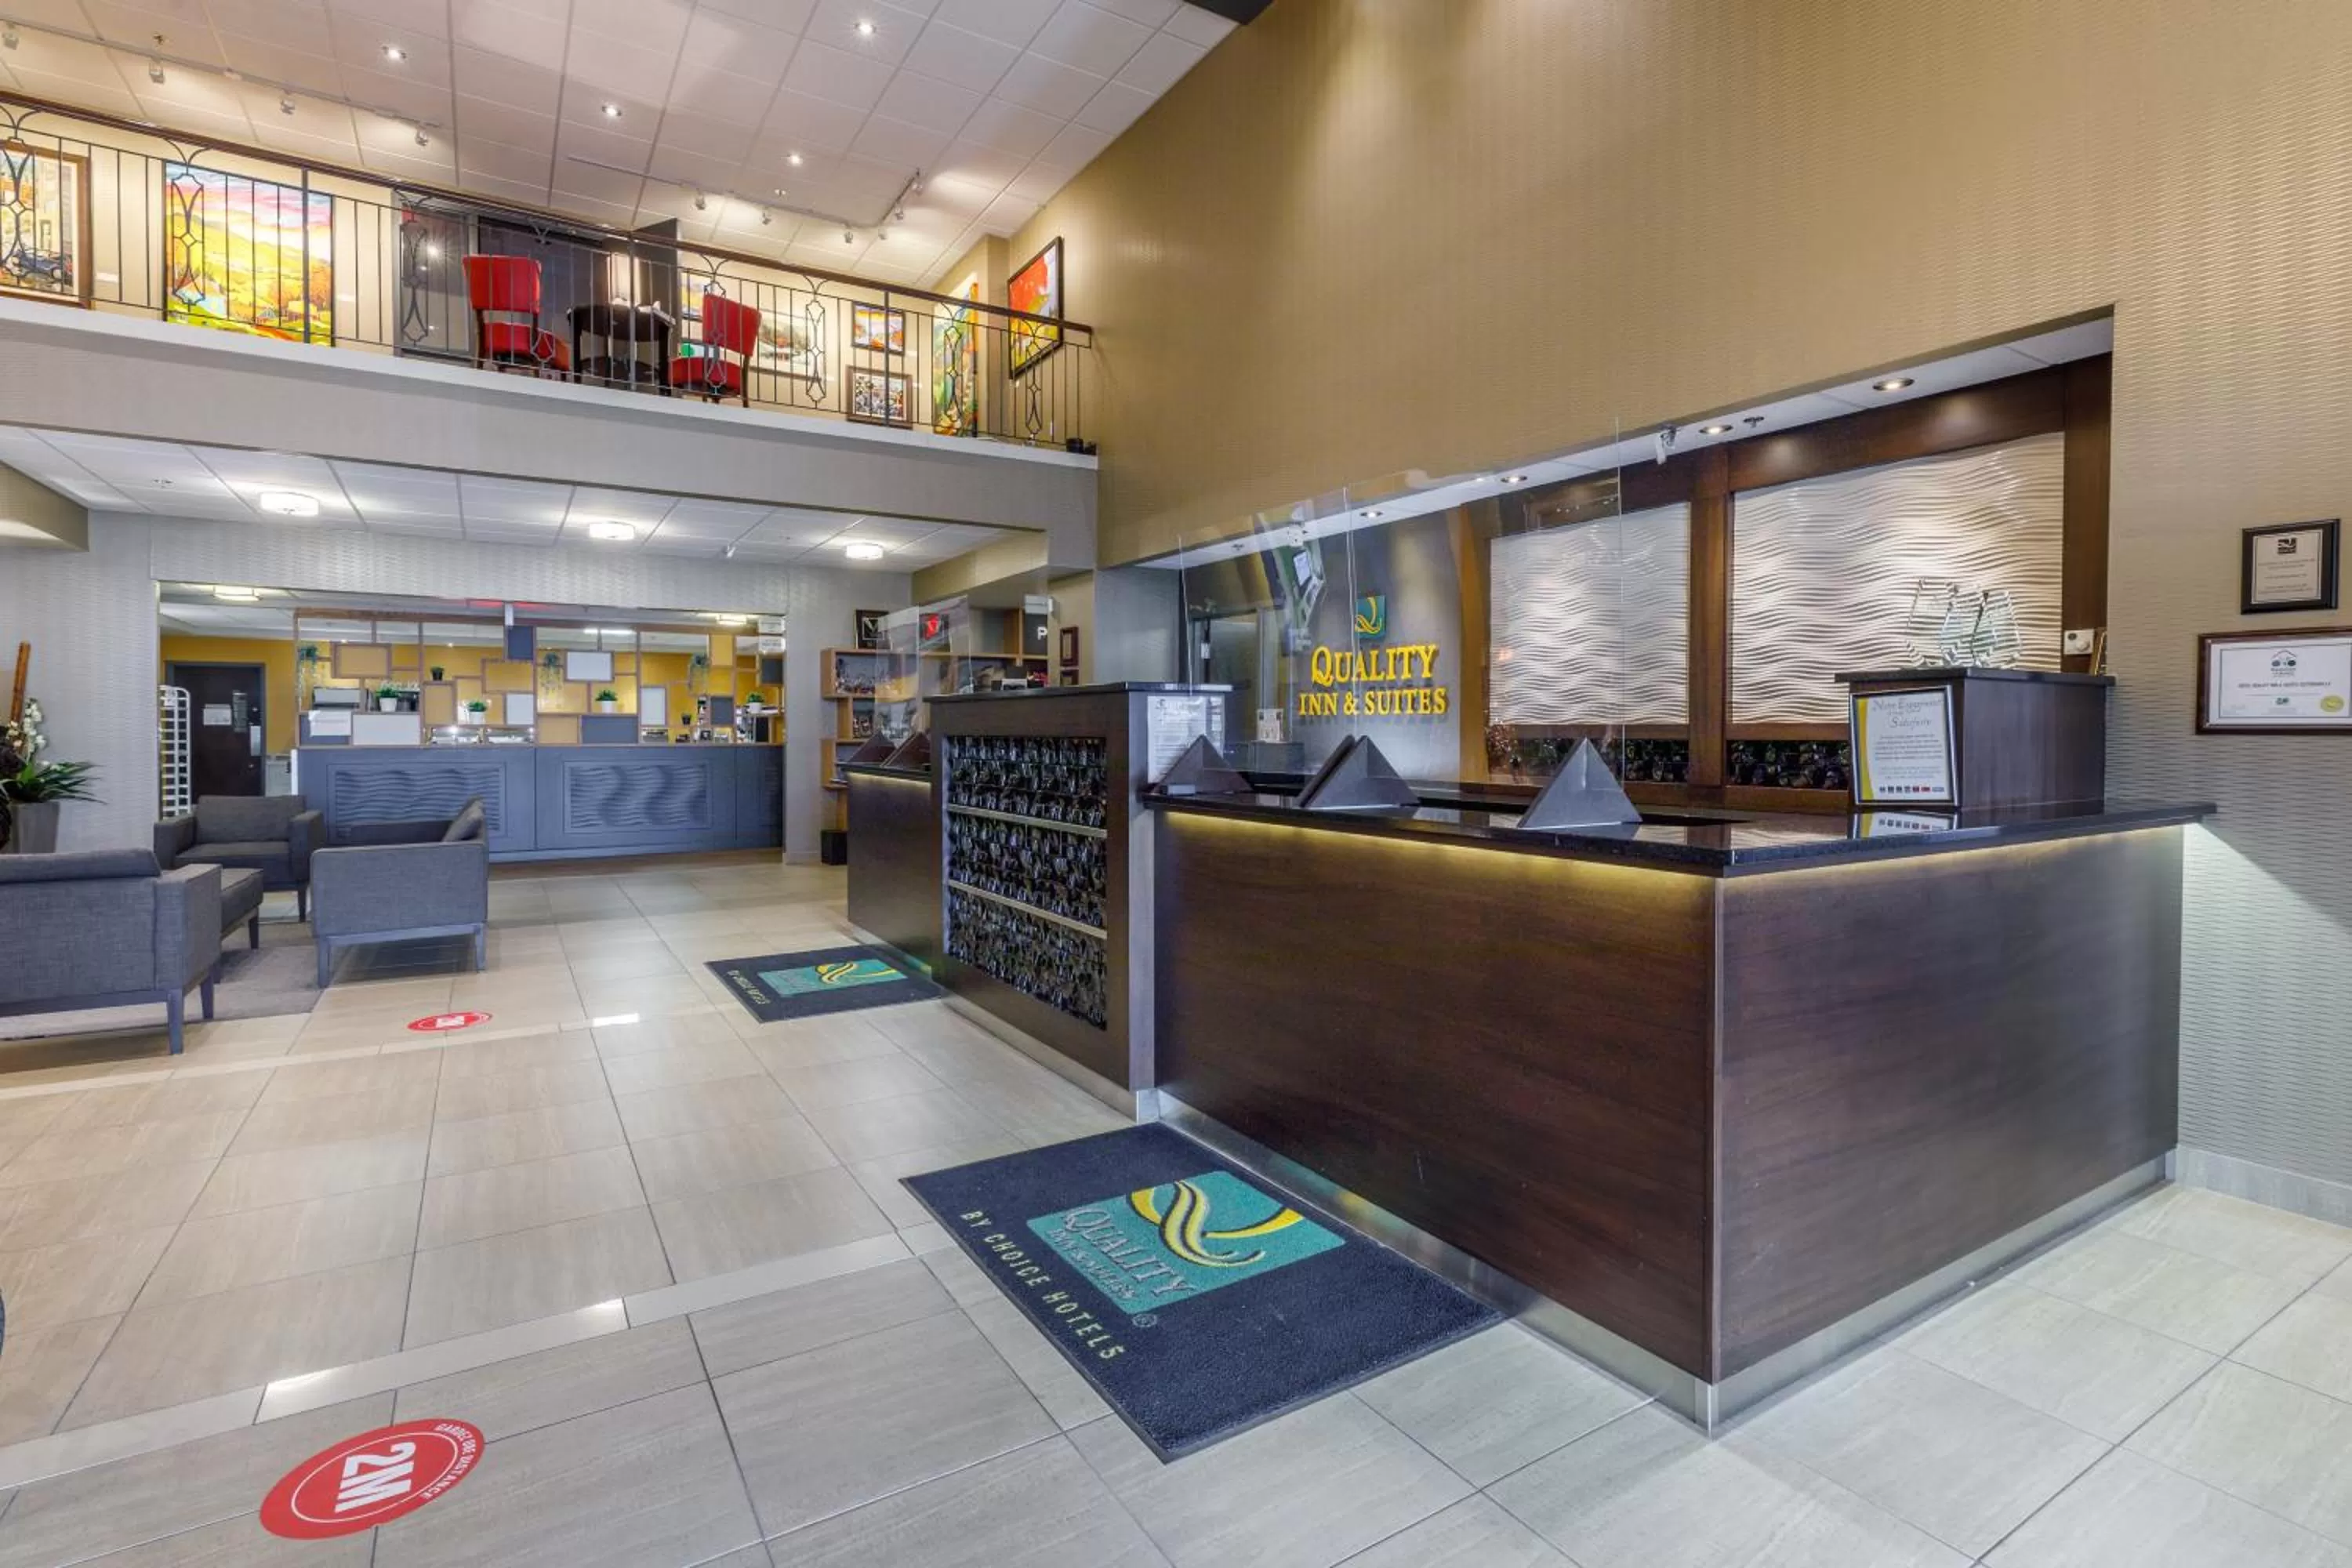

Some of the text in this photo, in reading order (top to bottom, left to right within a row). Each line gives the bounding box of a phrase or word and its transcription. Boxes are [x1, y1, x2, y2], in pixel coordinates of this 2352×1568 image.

[1311, 644, 1438, 687] QUALITY
[1298, 688, 1447, 717] INN & SUITES
[960, 1210, 1125, 1359] BY CHOICE HOTELS
[1062, 1208, 1196, 1297] QUALITY
[335, 1441, 416, 1513] 2M
